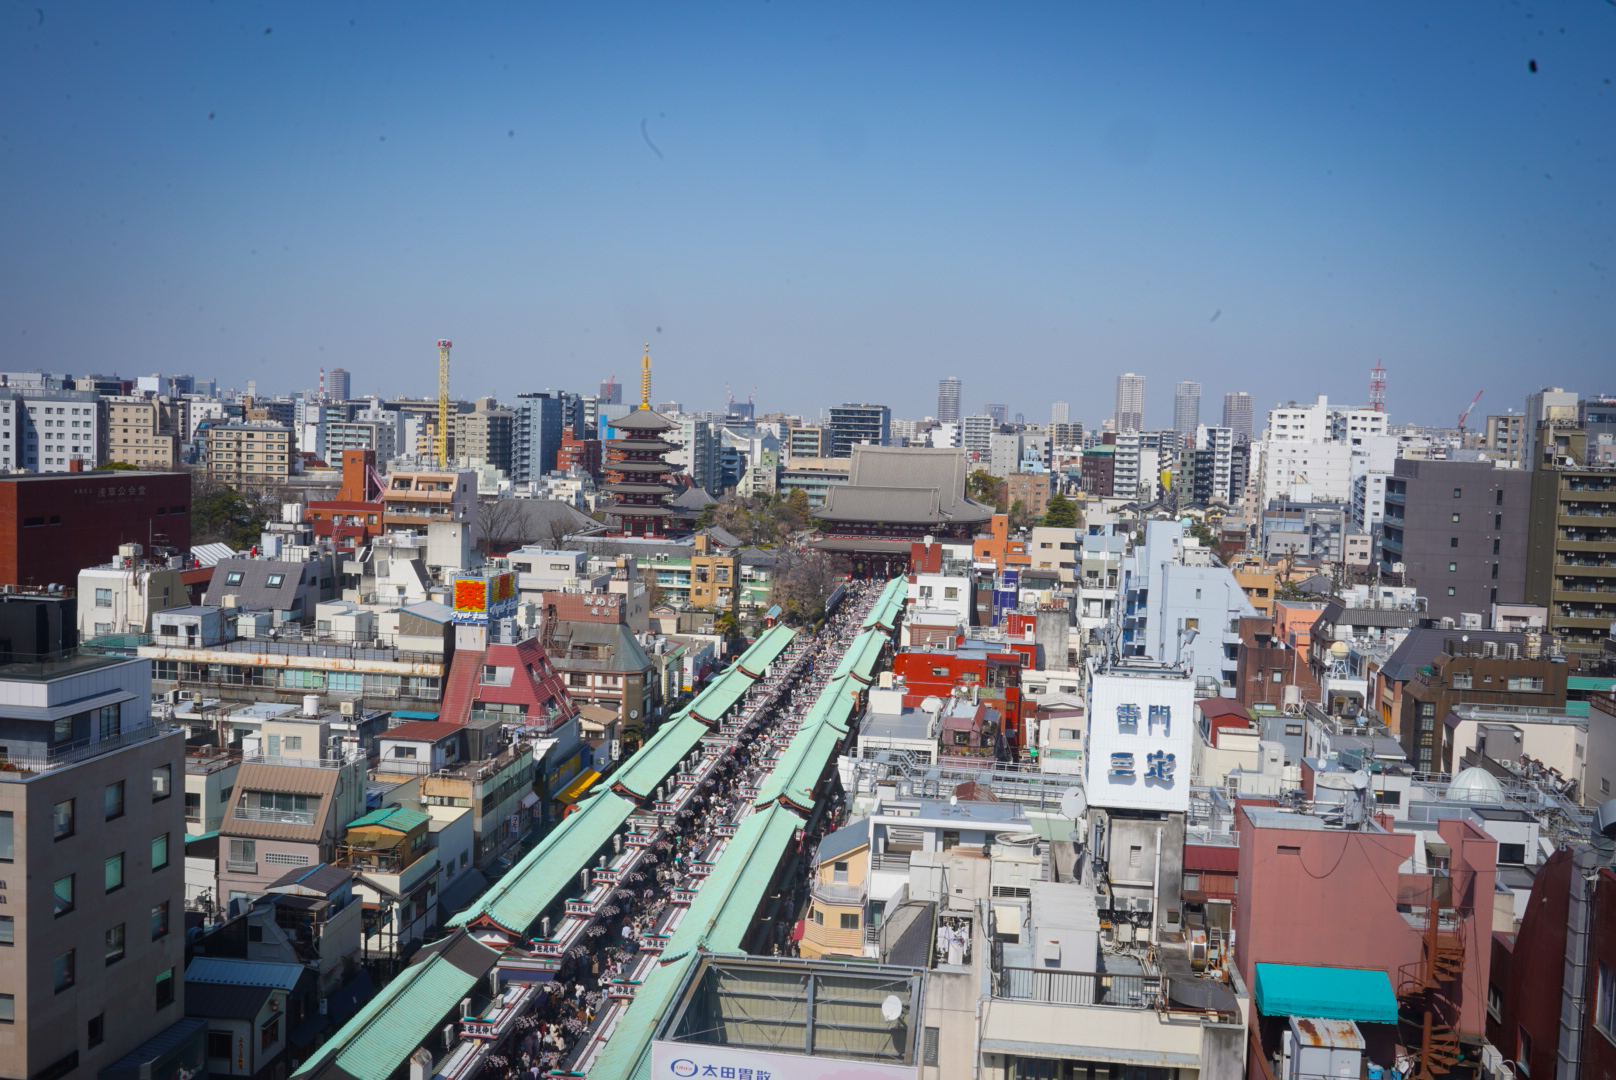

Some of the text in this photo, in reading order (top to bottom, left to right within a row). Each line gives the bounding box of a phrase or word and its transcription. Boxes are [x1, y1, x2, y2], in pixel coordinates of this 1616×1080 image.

[97, 485, 146, 498] 浅草公会堂
[455, 581, 486, 610] 薬
[1117, 703, 1171, 728] 雷門
[1108, 749, 1175, 780] 三定
[702, 1064, 772, 1080] 太田胃散
